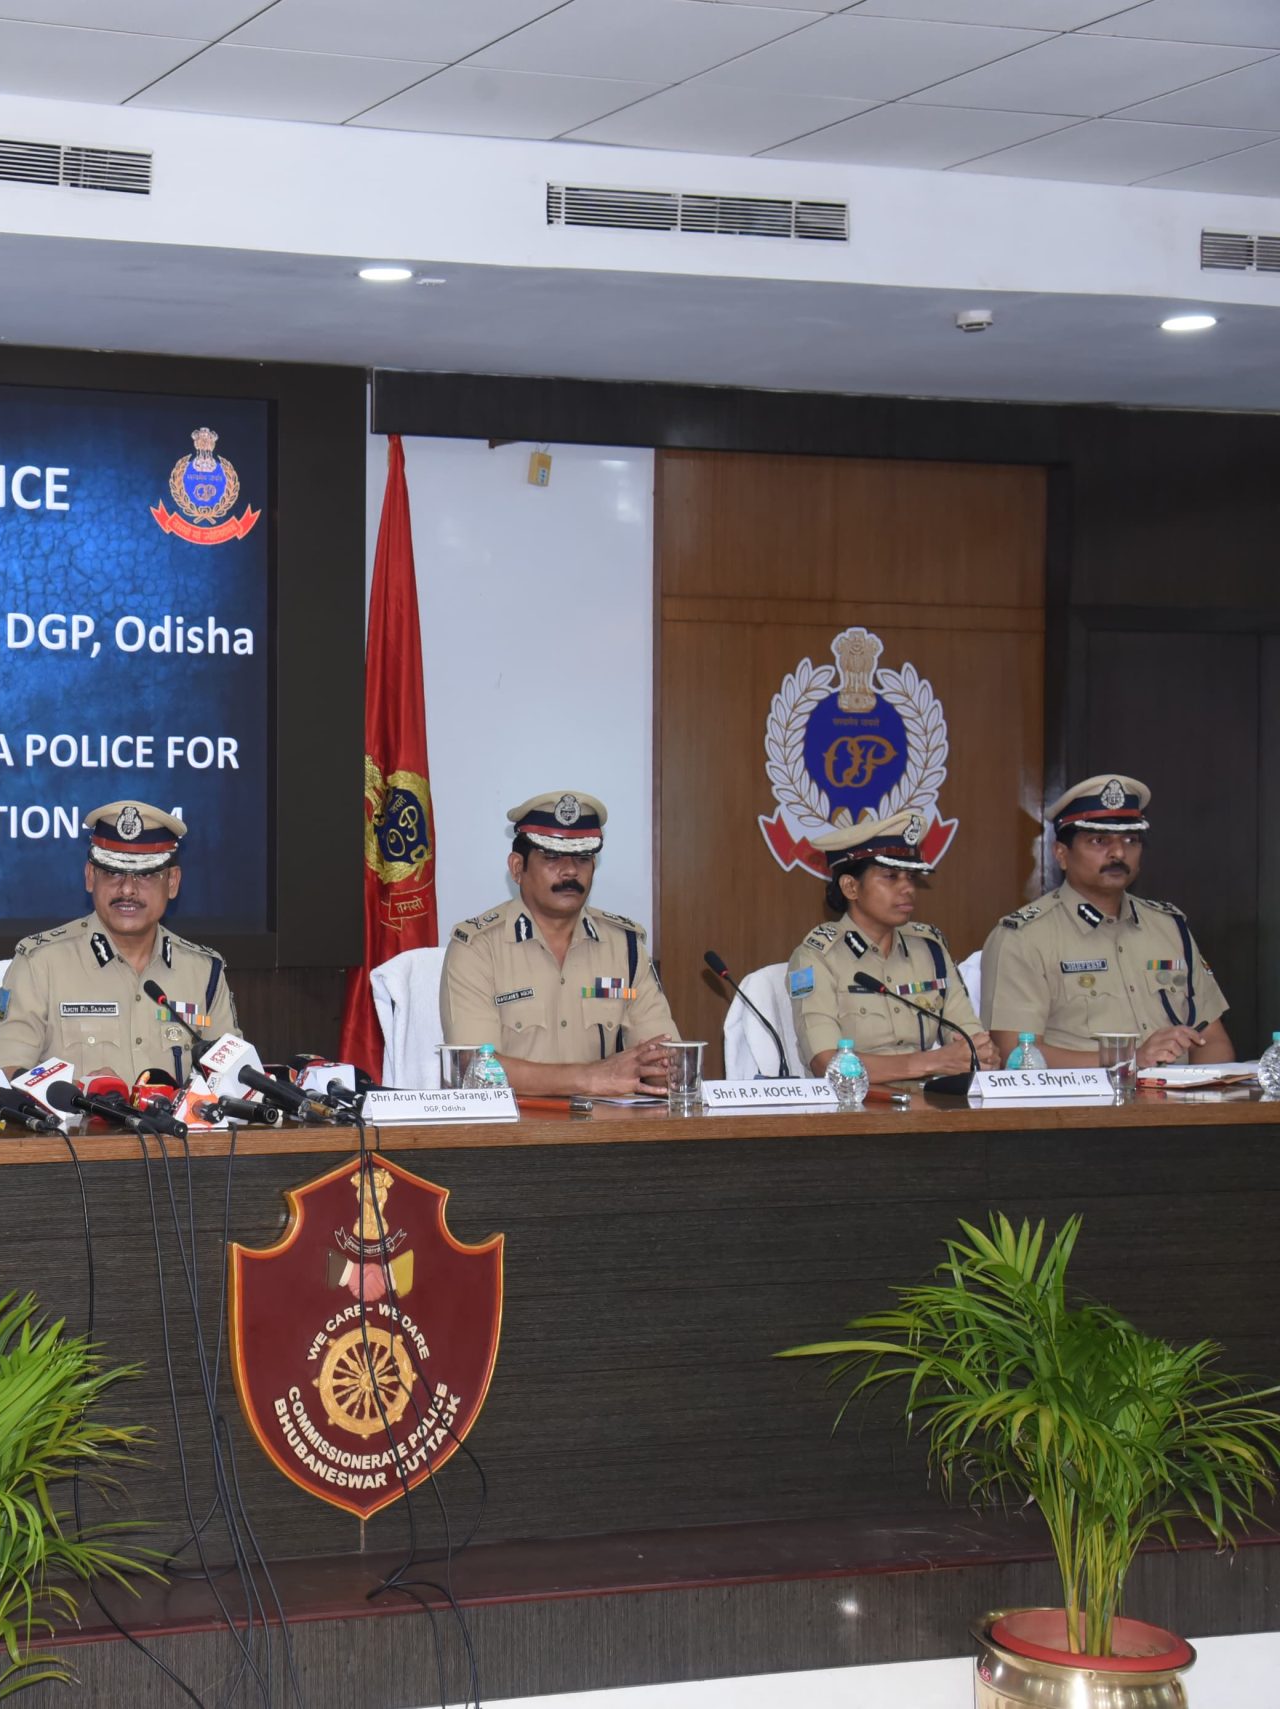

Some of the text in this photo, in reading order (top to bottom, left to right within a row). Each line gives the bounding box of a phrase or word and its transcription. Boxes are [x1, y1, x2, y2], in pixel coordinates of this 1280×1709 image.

[6, 612, 102, 658] DGP,
[115, 615, 255, 656] Odisha
[26, 734, 154, 768] POLICE
[167, 736, 240, 770] FOR
[371, 1089, 509, 1103] Shri Arun Kumar Sarangi, IPS
[712, 1085, 831, 1100] Shri R.P. KOCHE, IPS
[988, 1071, 1098, 1088] Smt S. Shyni, IPS
[441, 1104, 466, 1113] Odisha
[307, 1331, 328, 1361] WE
[325, 1304, 364, 1332] CARE
[401, 1315, 431, 1361] DARE
[273, 1393, 462, 1489] BHUBANESWAR CUTTACK
[288, 1382, 449, 1470] COMMISSIONERATE POLICE
